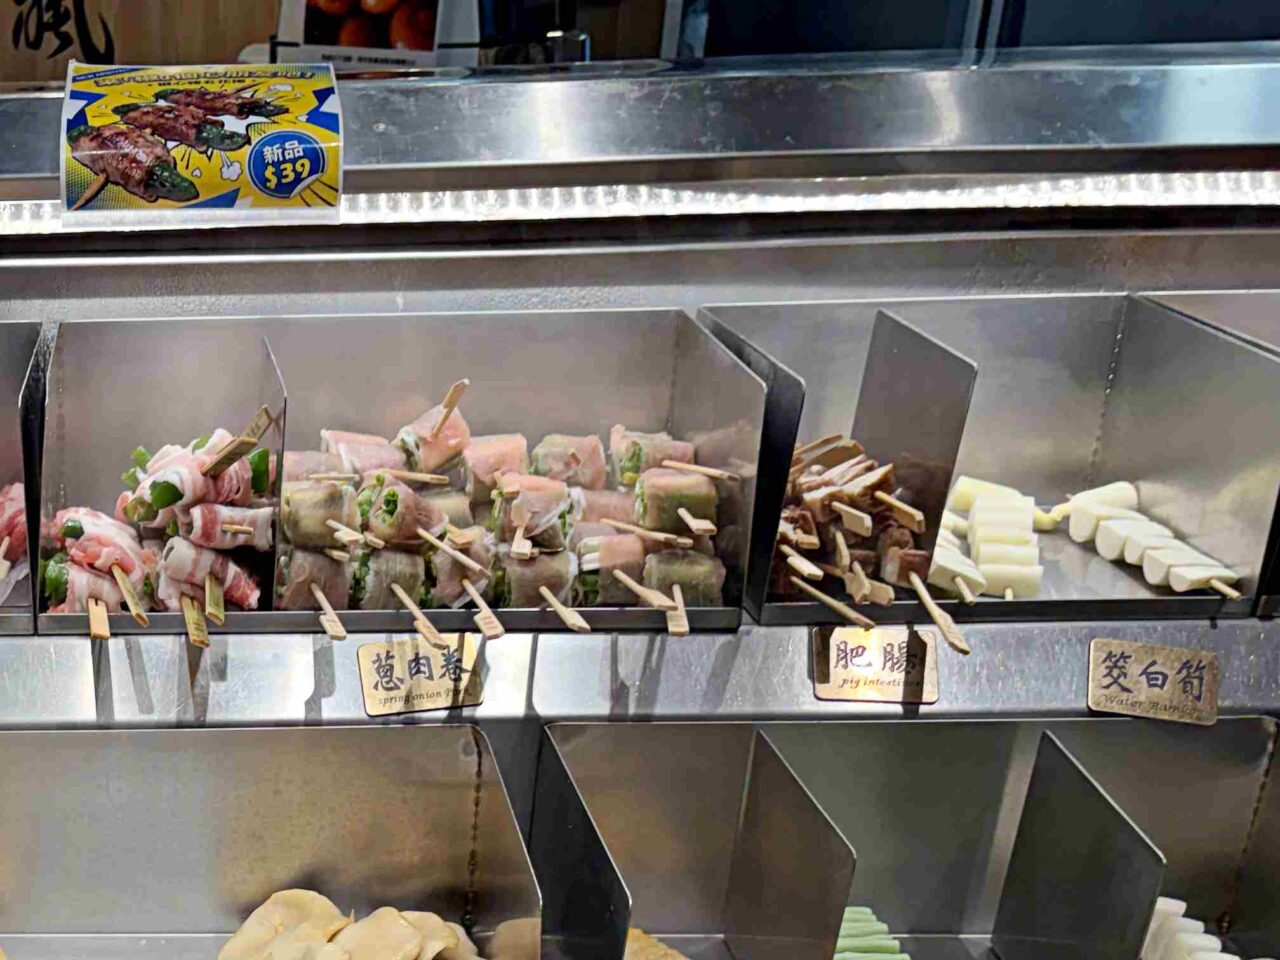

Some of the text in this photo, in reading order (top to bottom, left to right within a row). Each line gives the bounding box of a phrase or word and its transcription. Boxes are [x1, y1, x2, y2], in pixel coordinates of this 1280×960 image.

[262, 139, 305, 164] 新品
[264, 157, 311, 190] $39
[834, 640, 918, 674] 肥腸
[839, 676, 861, 688] pig
